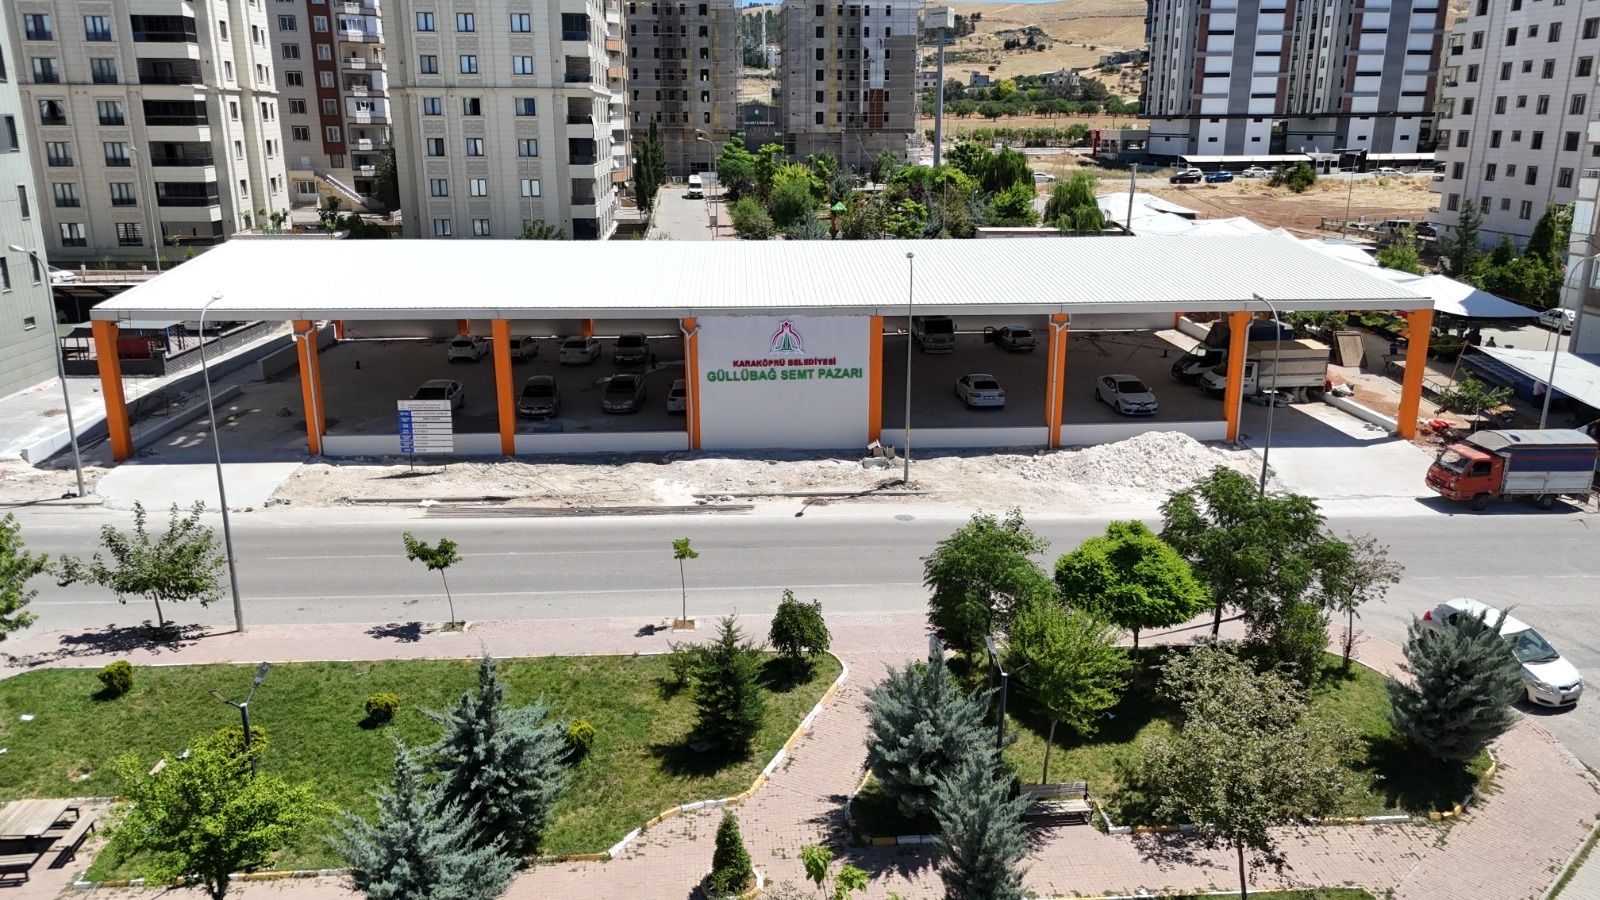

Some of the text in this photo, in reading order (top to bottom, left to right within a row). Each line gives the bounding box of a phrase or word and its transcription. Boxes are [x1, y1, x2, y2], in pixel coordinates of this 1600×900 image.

[732, 356, 836, 367] KARAKÖPRÜ BELEDİYESİ
[706, 368, 863, 382] GÜLLÜBAĞ SEMT PAZARI
